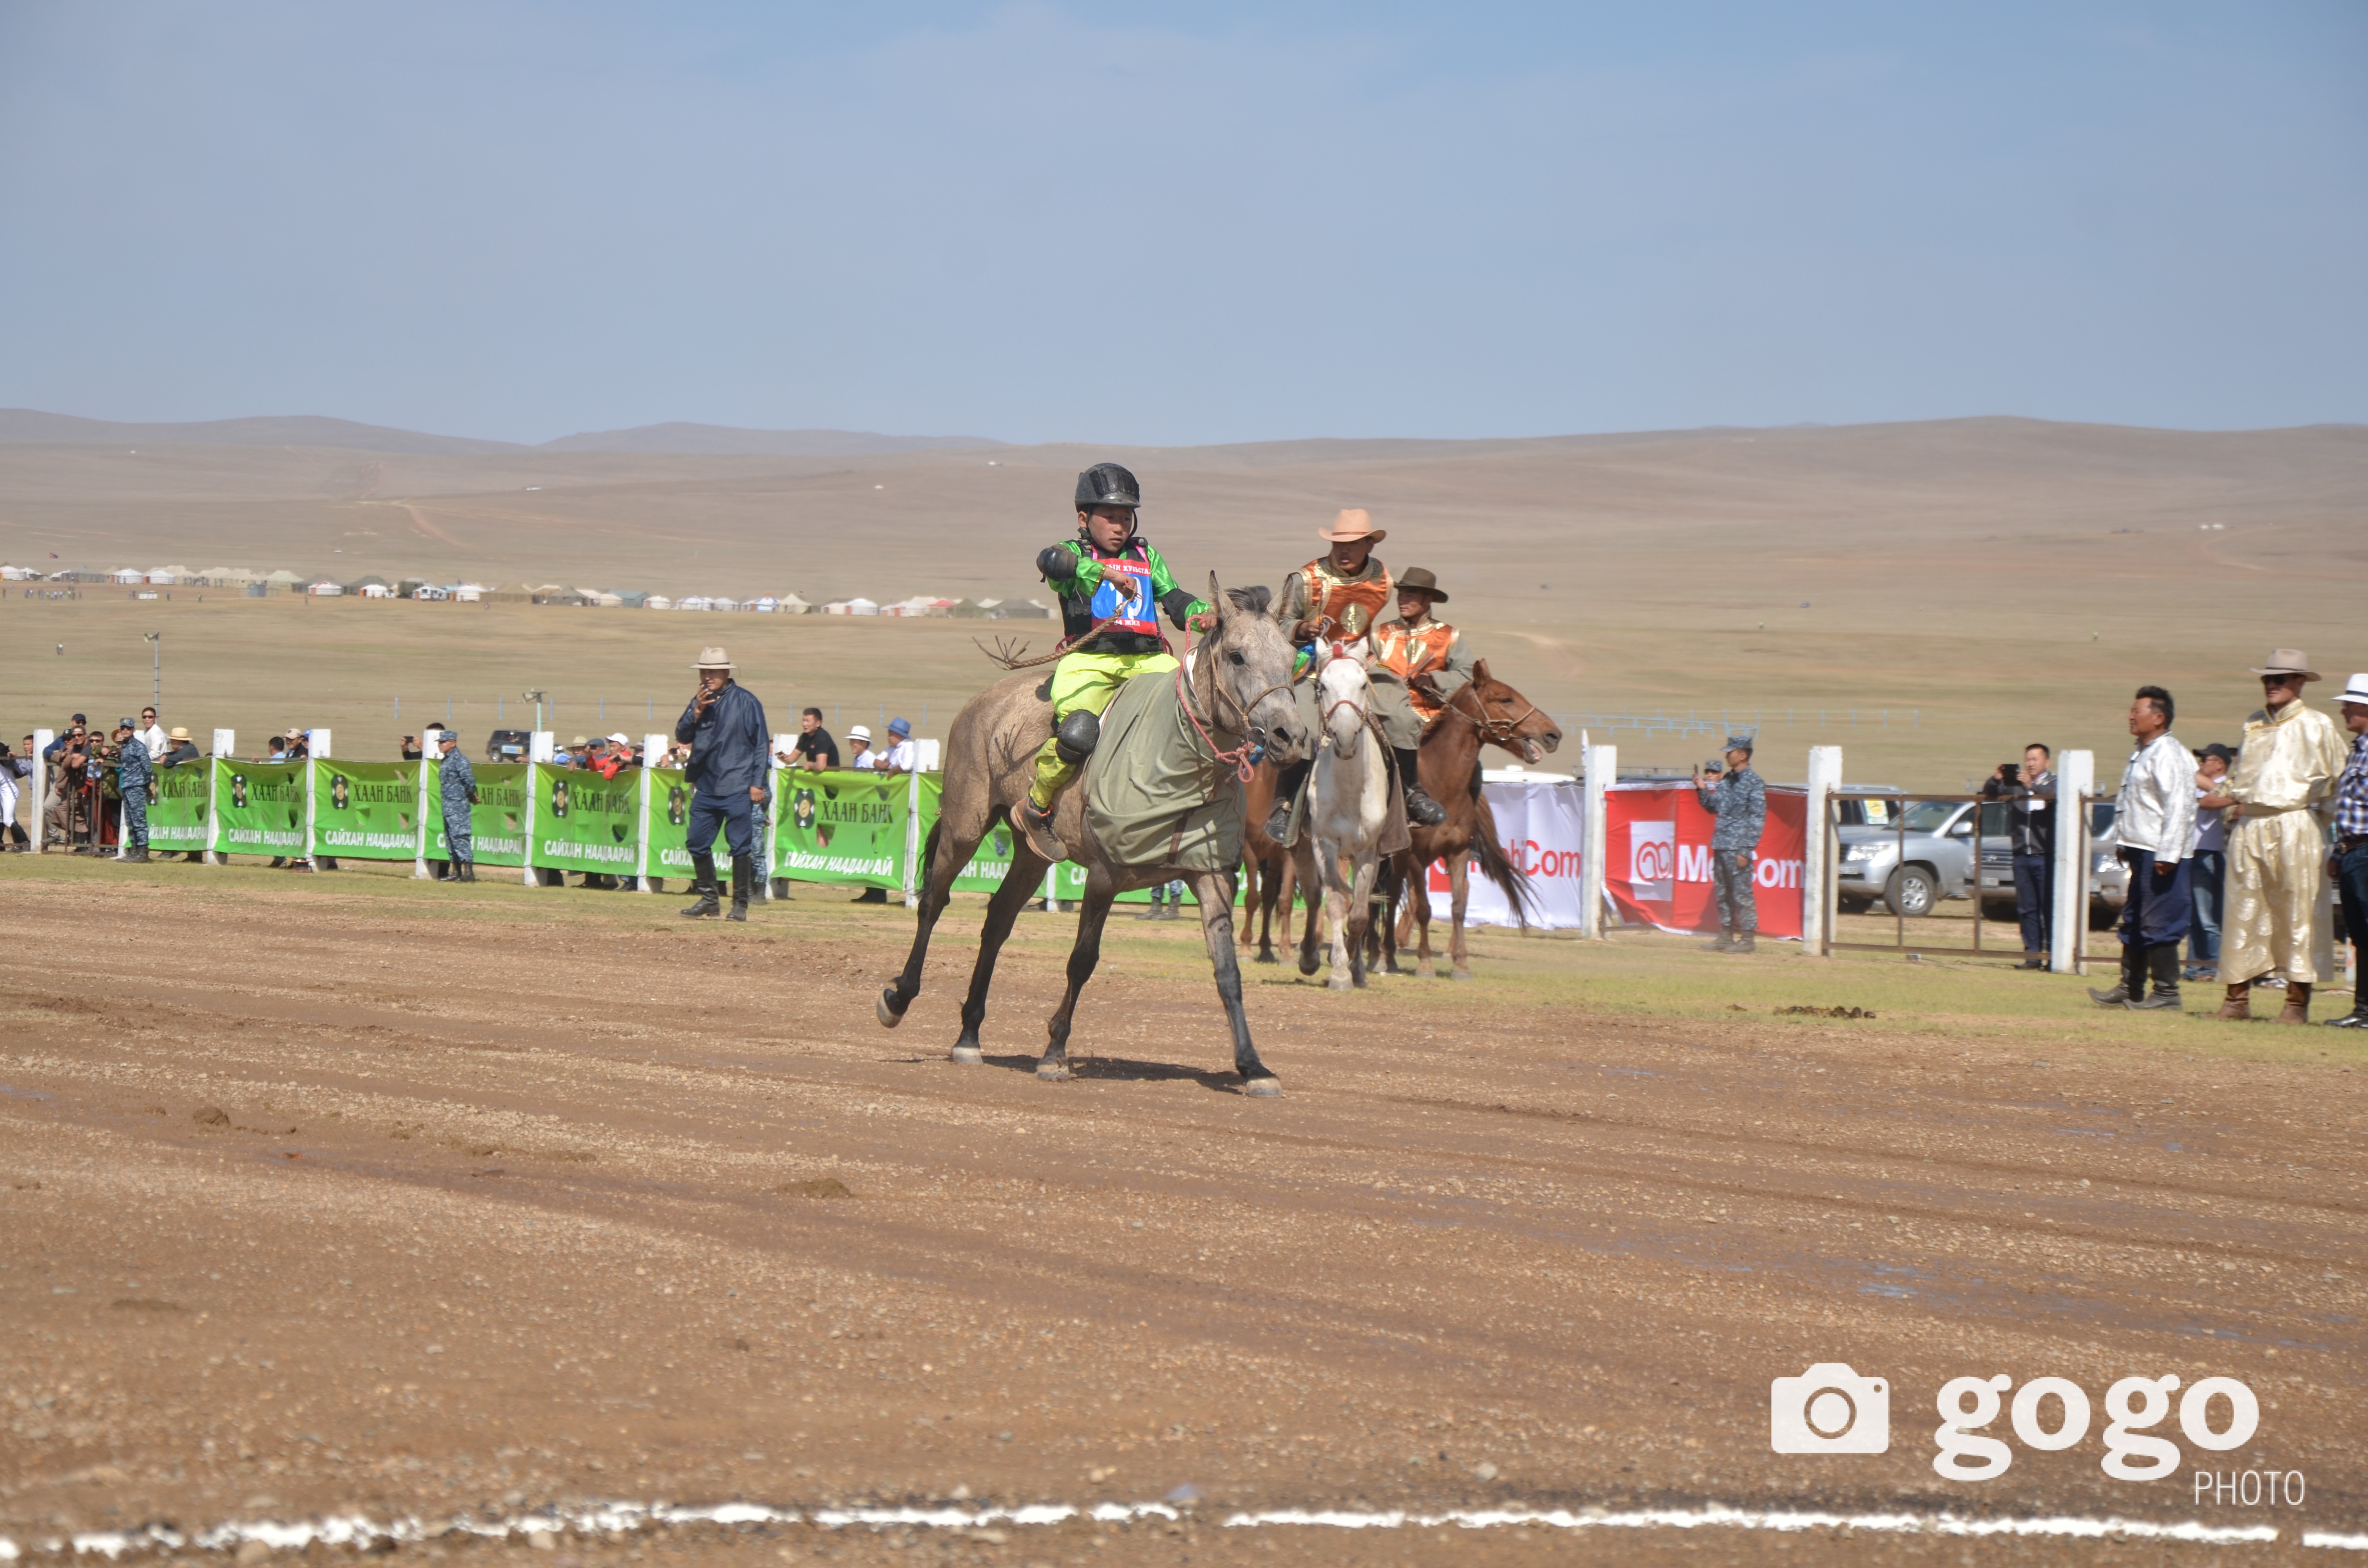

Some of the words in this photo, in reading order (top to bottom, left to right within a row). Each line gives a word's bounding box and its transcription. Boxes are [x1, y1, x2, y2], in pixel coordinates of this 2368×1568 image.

[1122, 565, 1150, 574] ХУВЬСГА
[251, 784, 278, 802] ХААН
[280, 785, 301, 803] БАНК
[353, 784, 383, 803] ХААН
[386, 786, 413, 803] БАНК
[496, 788, 520, 808] БАНК
[572, 792, 603, 812] ХААН
[605, 794, 630, 814] БАНК
[821, 801, 857, 822] ХААН
[861, 803, 894, 824] БАНК
[148, 823, 169, 839] ЙХАН
[228, 826, 261, 844] САЙХАН
[263, 830, 304, 848] НААДААРАЙ
[325, 828, 364, 846] САЙХАН
[365, 831, 416, 850] НААДААРАЙ
[477, 836, 522, 855] НААДААРАЙ
[544, 838, 582, 858] САЙХАН
[584, 845, 635, 863] НААДААРАЙ
[660, 846, 694, 866] САЙХА
[1470, 839, 1581, 878] biCom
